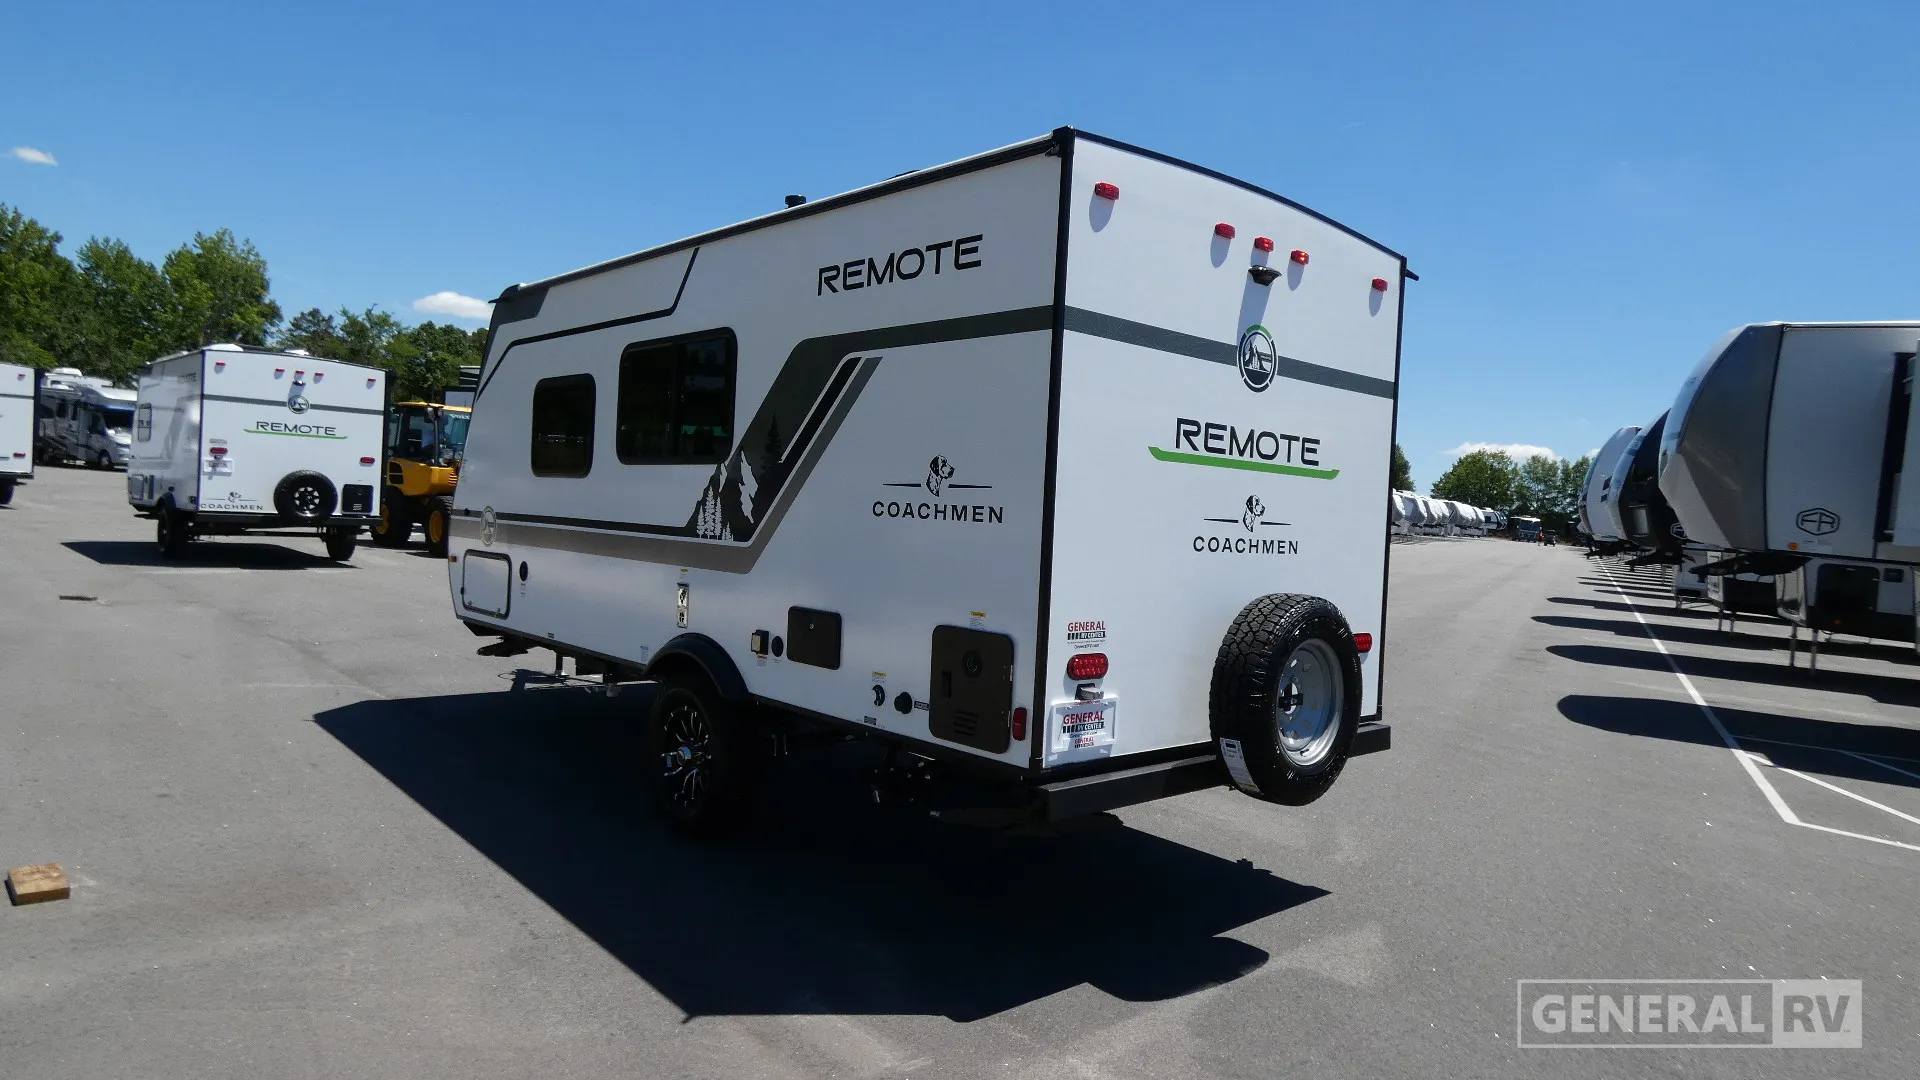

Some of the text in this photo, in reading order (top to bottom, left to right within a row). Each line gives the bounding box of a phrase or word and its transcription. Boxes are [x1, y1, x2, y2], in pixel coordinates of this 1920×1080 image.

[817, 233, 984, 297] REMOTE
[256, 421, 337, 436] REMOTE
[1175, 417, 1321, 467] REMOTE
[200, 502, 264, 511] COACHMEN
[872, 500, 1004, 524] COACHMEN
[1192, 535, 1299, 555] COACHMEN
[1067, 620, 1106, 632] GENERAL
[1063, 710, 1105, 725] GENERAL
[1085, 722, 1102, 730] CENTER
